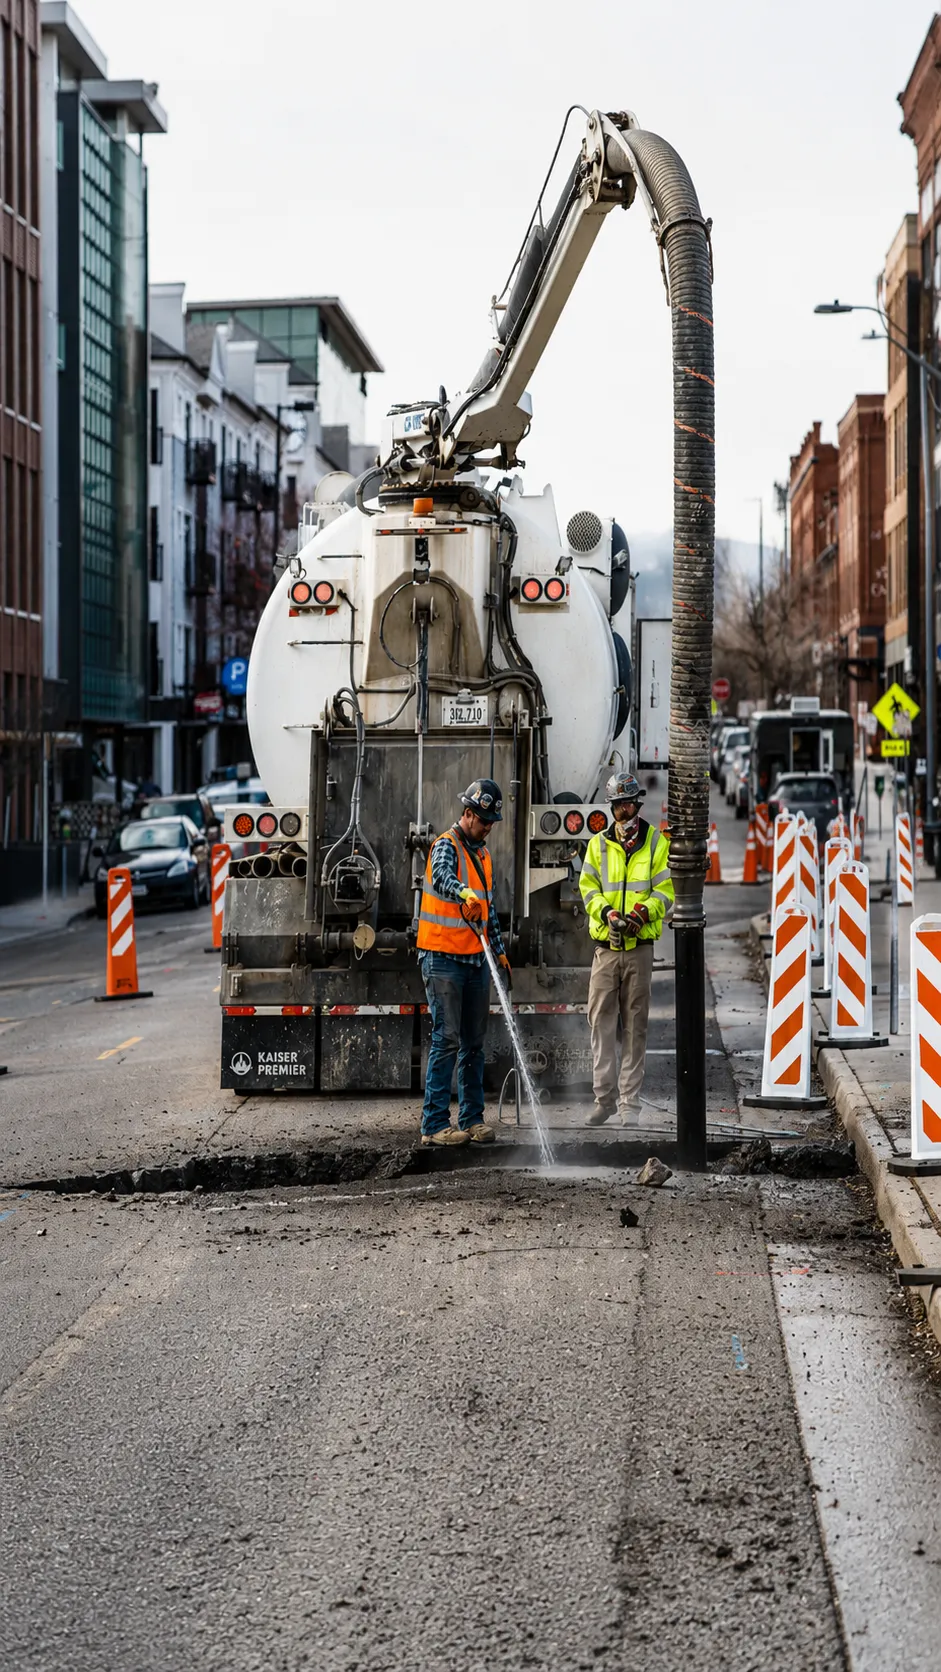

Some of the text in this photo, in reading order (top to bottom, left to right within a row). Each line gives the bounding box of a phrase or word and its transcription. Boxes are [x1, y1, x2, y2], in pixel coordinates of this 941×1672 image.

[231, 661, 246, 681] P
[258, 1052, 298, 1062] KAISER
[258, 1065, 306, 1075] PREMIER
